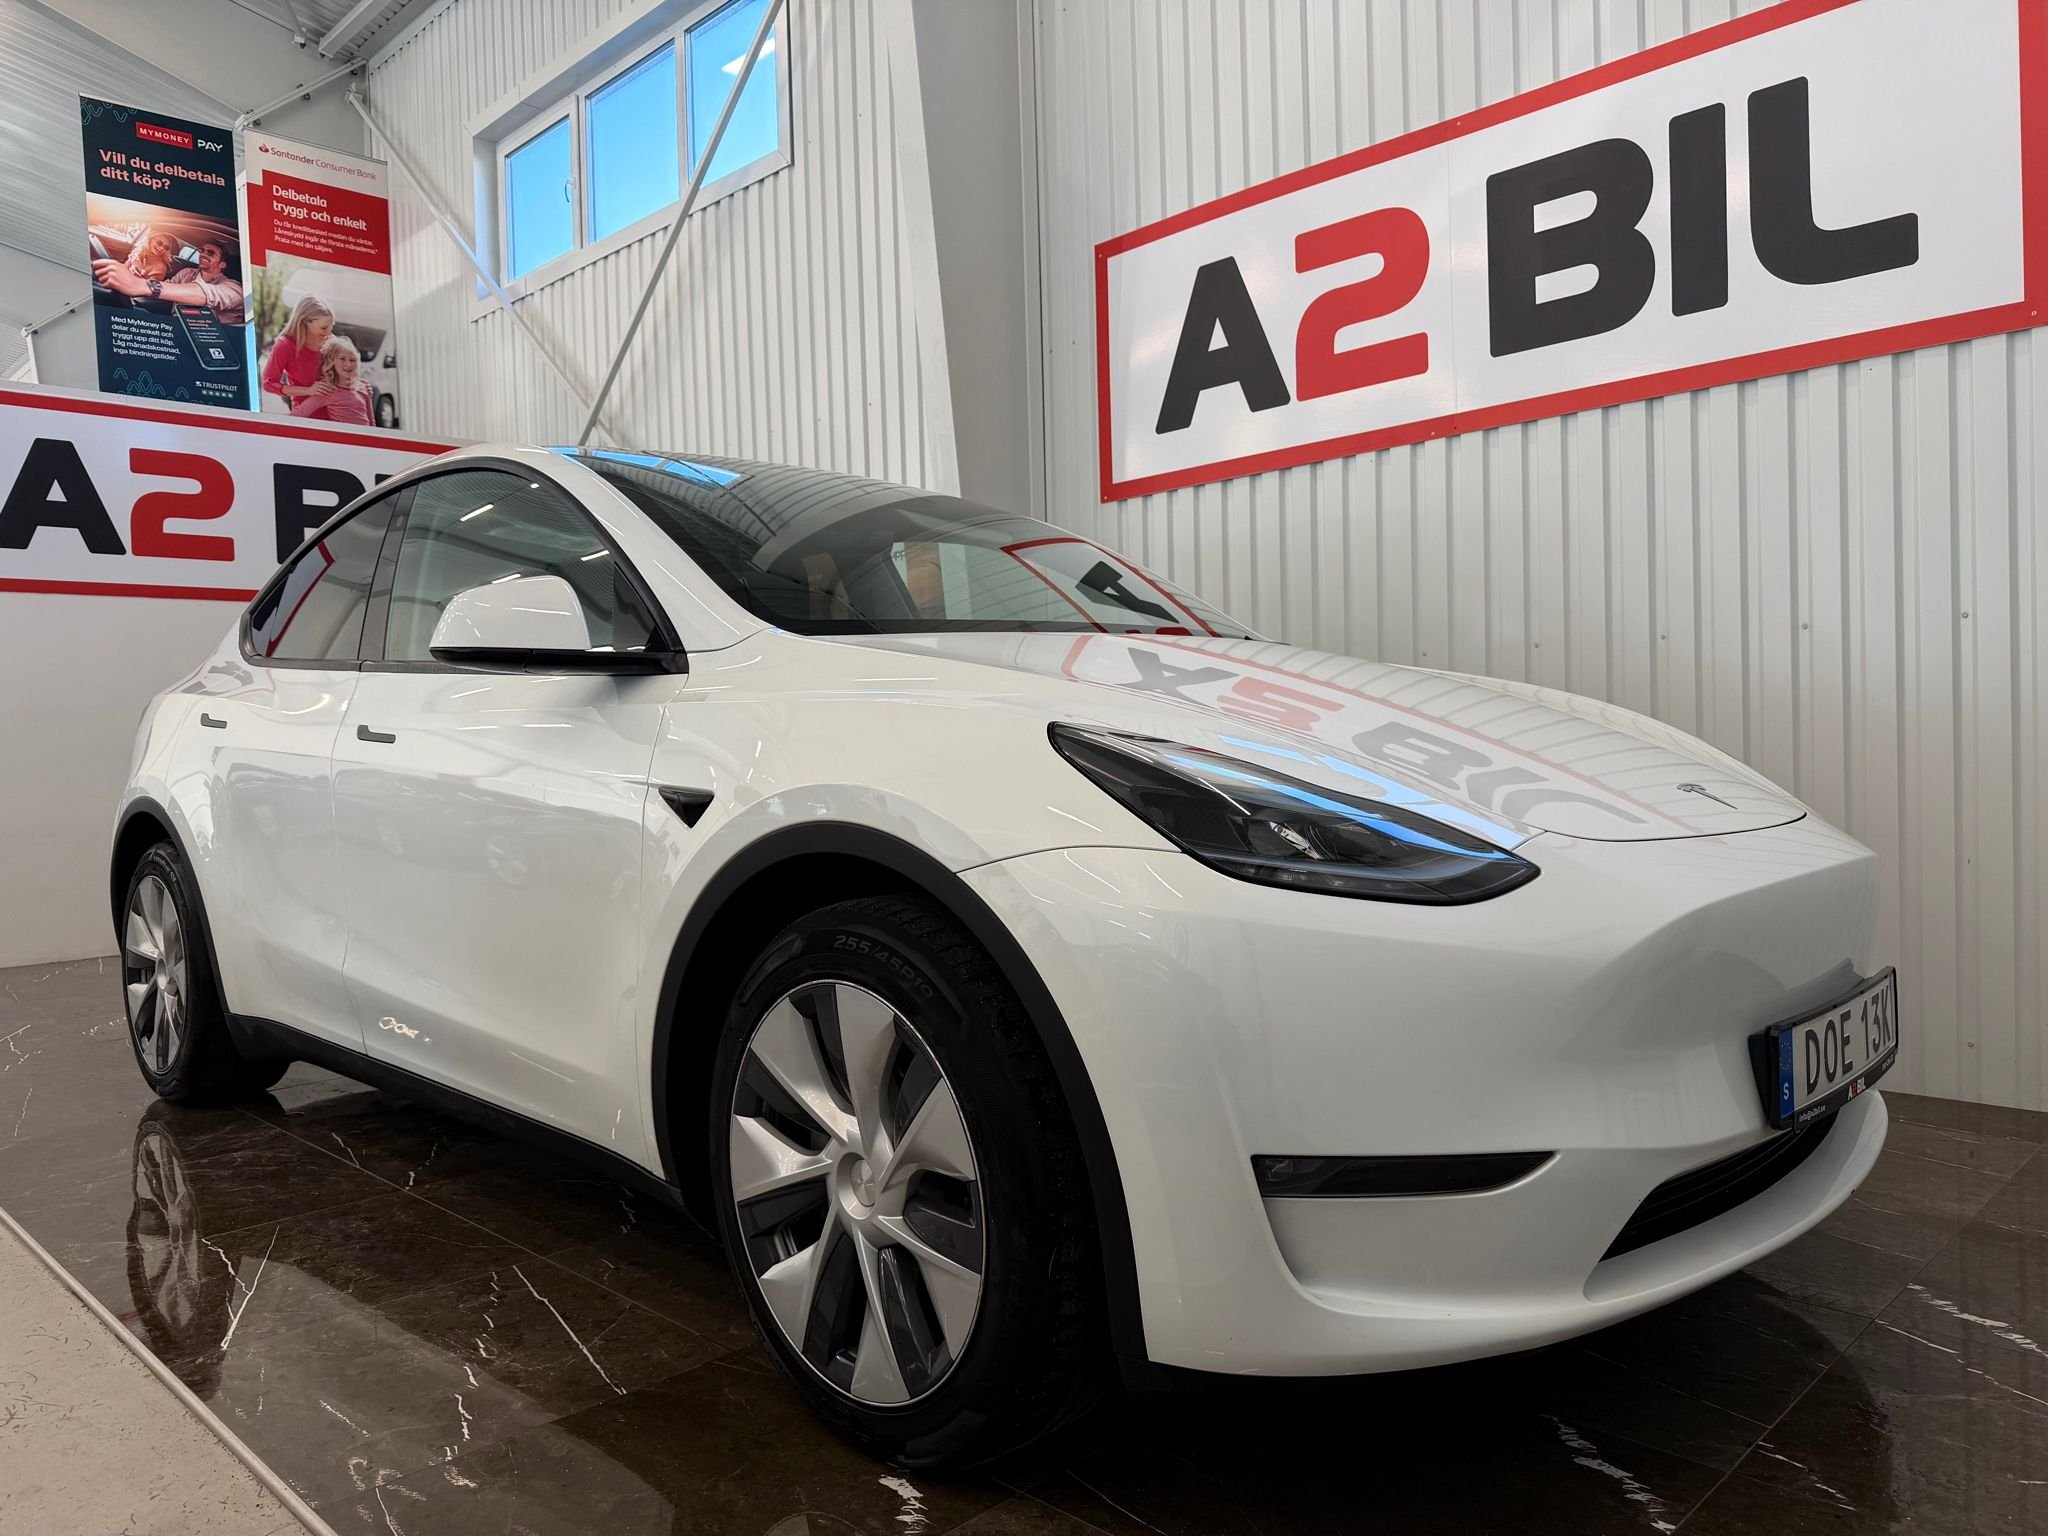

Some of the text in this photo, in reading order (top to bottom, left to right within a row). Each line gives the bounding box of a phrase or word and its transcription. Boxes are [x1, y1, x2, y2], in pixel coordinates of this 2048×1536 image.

[140, 127, 224, 152] MYMONEY PAY
[99, 148, 226, 187] Vill du delbetala
[271, 148, 377, 180] Santander Consumer Bank
[100, 166, 171, 190] ditt köp?
[272, 184, 328, 208] Delbetala
[272, 200, 367, 231] tryggt och enkelt
[274, 227, 305, 240] Låneskydd
[304, 235, 319, 244] ingår
[327, 238, 344, 248] första
[274, 235, 290, 244] Prata
[290, 239, 304, 247] med
[304, 242, 314, 250] din
[328, 231, 348, 241] medan
[1155, 75, 1919, 435] A2 BIL
[127, 318, 160, 329] MyMoney
[160, 322, 173, 331] Pay
[140, 328, 161, 337] enkelt
[112, 331, 133, 340] tryggt
[148, 336, 160, 344] ditt
[160, 338, 175, 346] köp.
[112, 338, 126, 347] Låg
[129, 348, 177, 360] bindningstider.
[201, 381, 238, 392] TRUSTPILOT
[0, 437, 235, 562] A2
[1805, 984, 1891, 1096] DOE 13K
[1783, 1082, 1790, 1100] S
